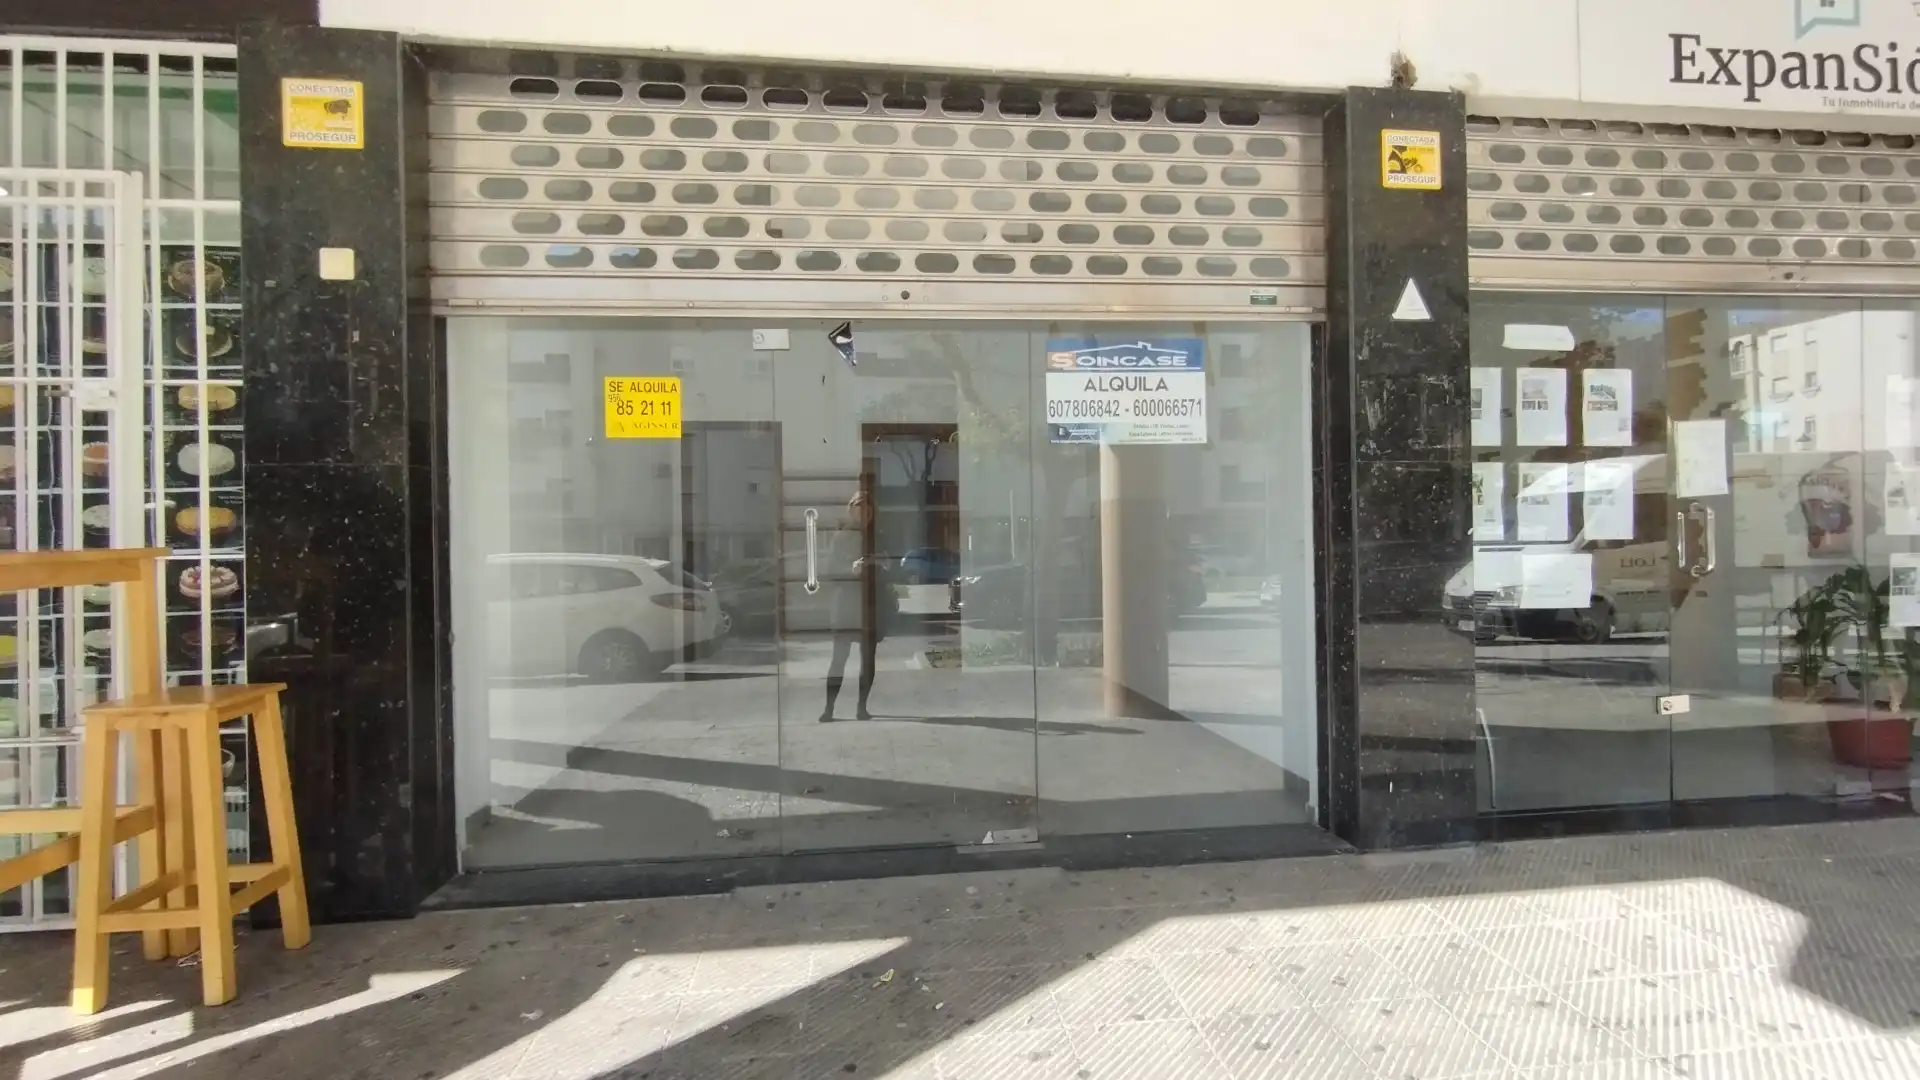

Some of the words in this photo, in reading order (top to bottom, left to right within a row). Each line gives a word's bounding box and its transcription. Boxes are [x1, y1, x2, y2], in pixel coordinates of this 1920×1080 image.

[289, 83, 354, 93] CONECTADA
[1821, 96, 1836, 107] Tu
[1838, 98, 1906, 109] Inmobiliaria
[289, 131, 356, 142] PROSEGUR
[1387, 135, 1435, 144] CONECTADA
[1388, 175, 1436, 184] PROSEGUR
[1051, 353, 1188, 367] SOINCASE
[609, 381, 624, 393] SE
[630, 382, 678, 393] ALQUILA
[1084, 376, 1169, 392] ALQUILA
[616, 400, 633, 416] 85
[640, 400, 654, 416] 21
[661, 400, 671, 416] 11
[1048, 399, 1120, 417] 607806842
[1133, 399, 1202, 416] 600066571
